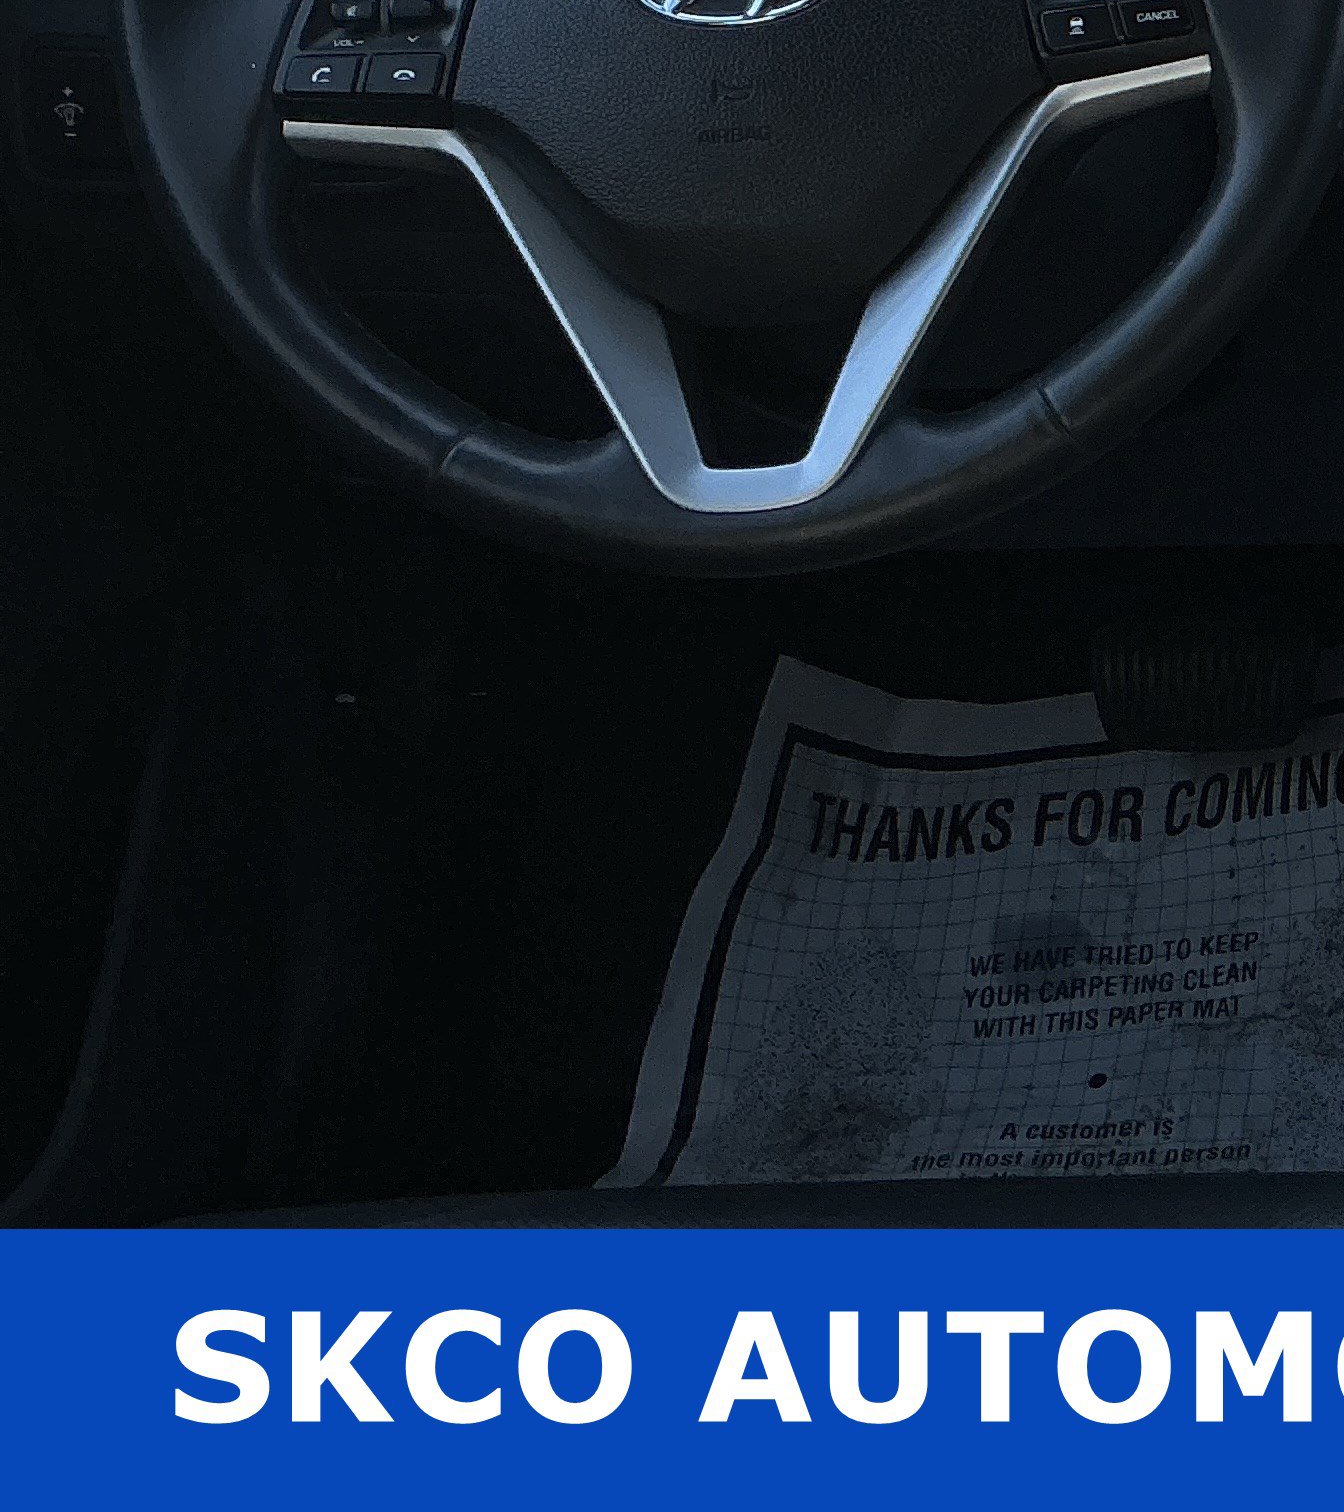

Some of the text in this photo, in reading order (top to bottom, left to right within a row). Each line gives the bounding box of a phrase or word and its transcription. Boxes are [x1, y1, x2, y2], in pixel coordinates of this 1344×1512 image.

[1136, 9, 1180, 23] CANCEL
[811, 791, 1016, 864] THANKS
[1033, 786, 1143, 847] FOR
[970, 931, 1259, 978] WE HAVE TRIED TO KEEP
[964, 960, 1258, 1009] YOUR CARPETING CLEAN
[973, 995, 1241, 1039] WITH THIS PAPER MAT
[999, 1117, 1174, 1141] A customer is
[911, 1142, 1252, 1172] the most important person
